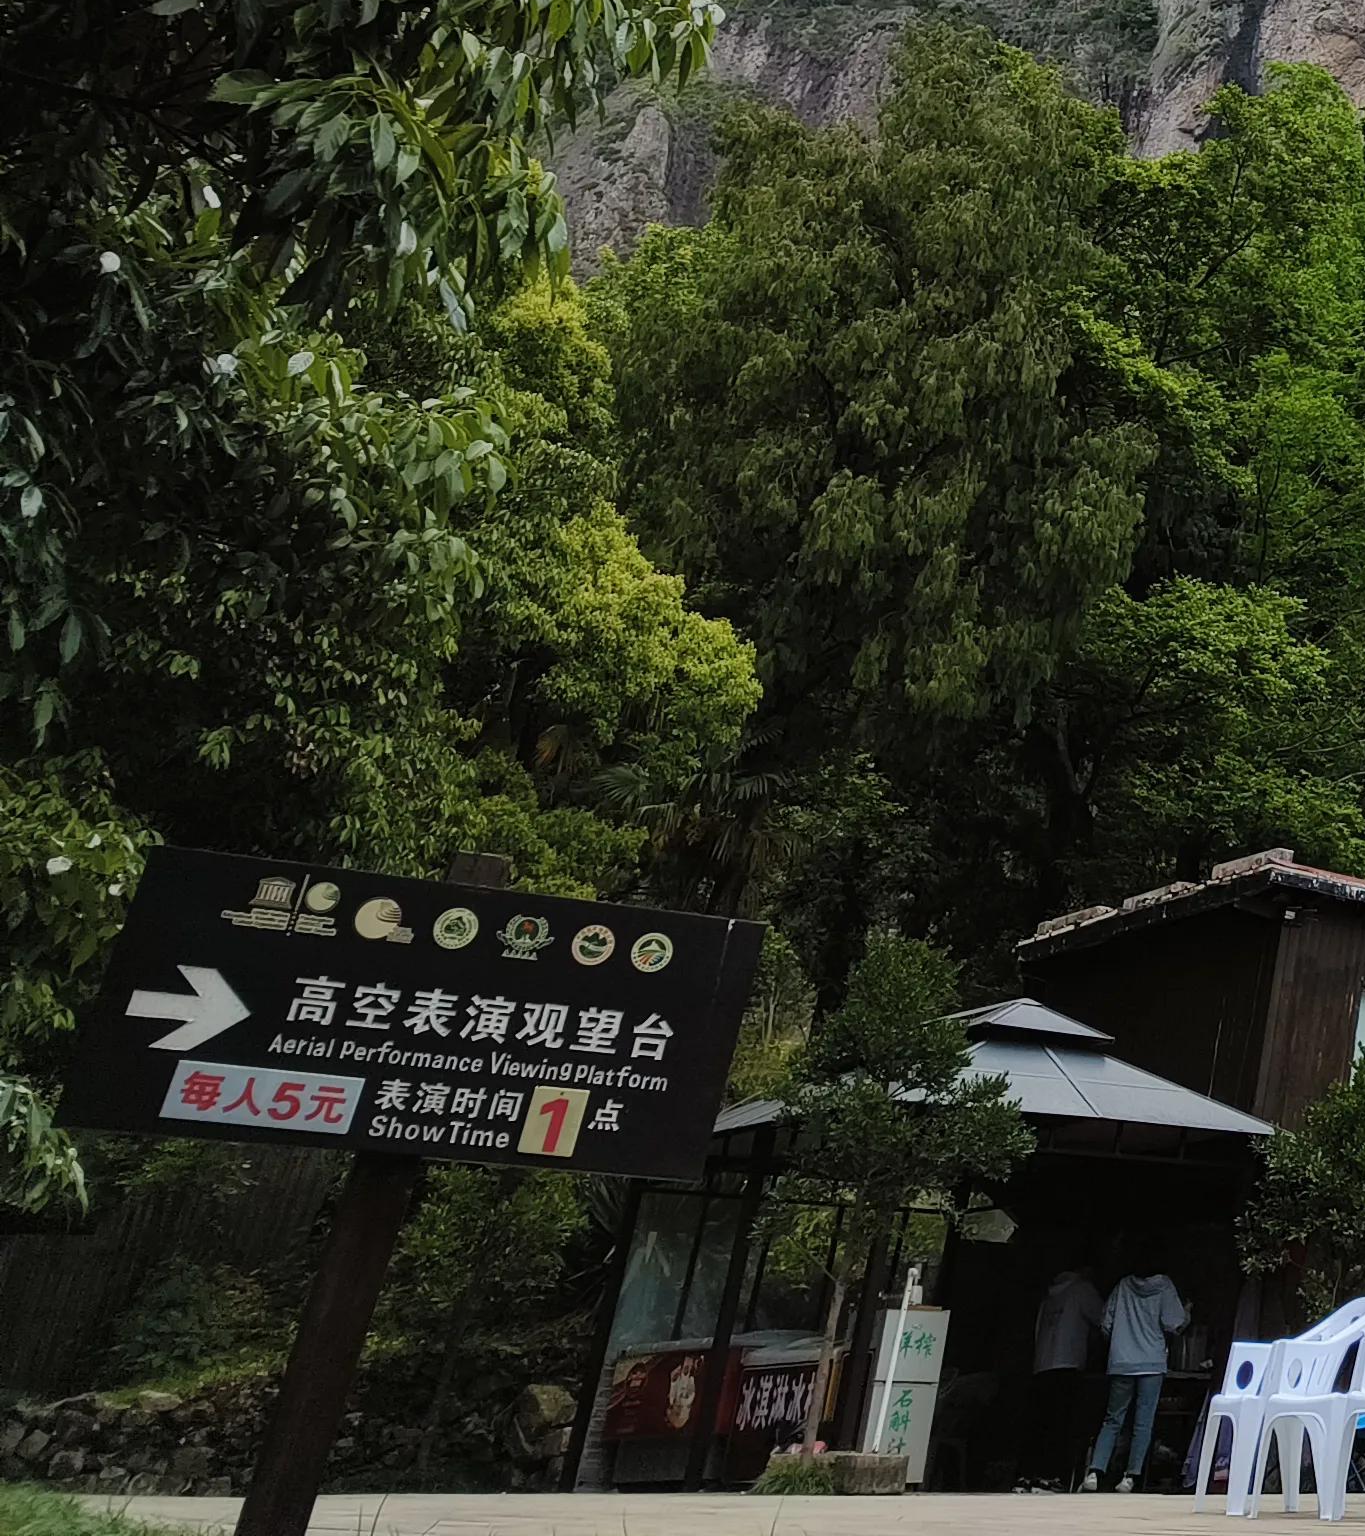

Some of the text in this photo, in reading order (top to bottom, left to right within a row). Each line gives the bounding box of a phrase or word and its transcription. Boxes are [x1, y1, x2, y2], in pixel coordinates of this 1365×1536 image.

[286, 975, 674, 1061] 高空表演观望台
[268, 1033, 335, 1058] Aerial
[339, 1040, 483, 1073] Performance
[181, 1071, 347, 1123] 每人5元
[374, 1079, 624, 1152] 表演时间 1 点
